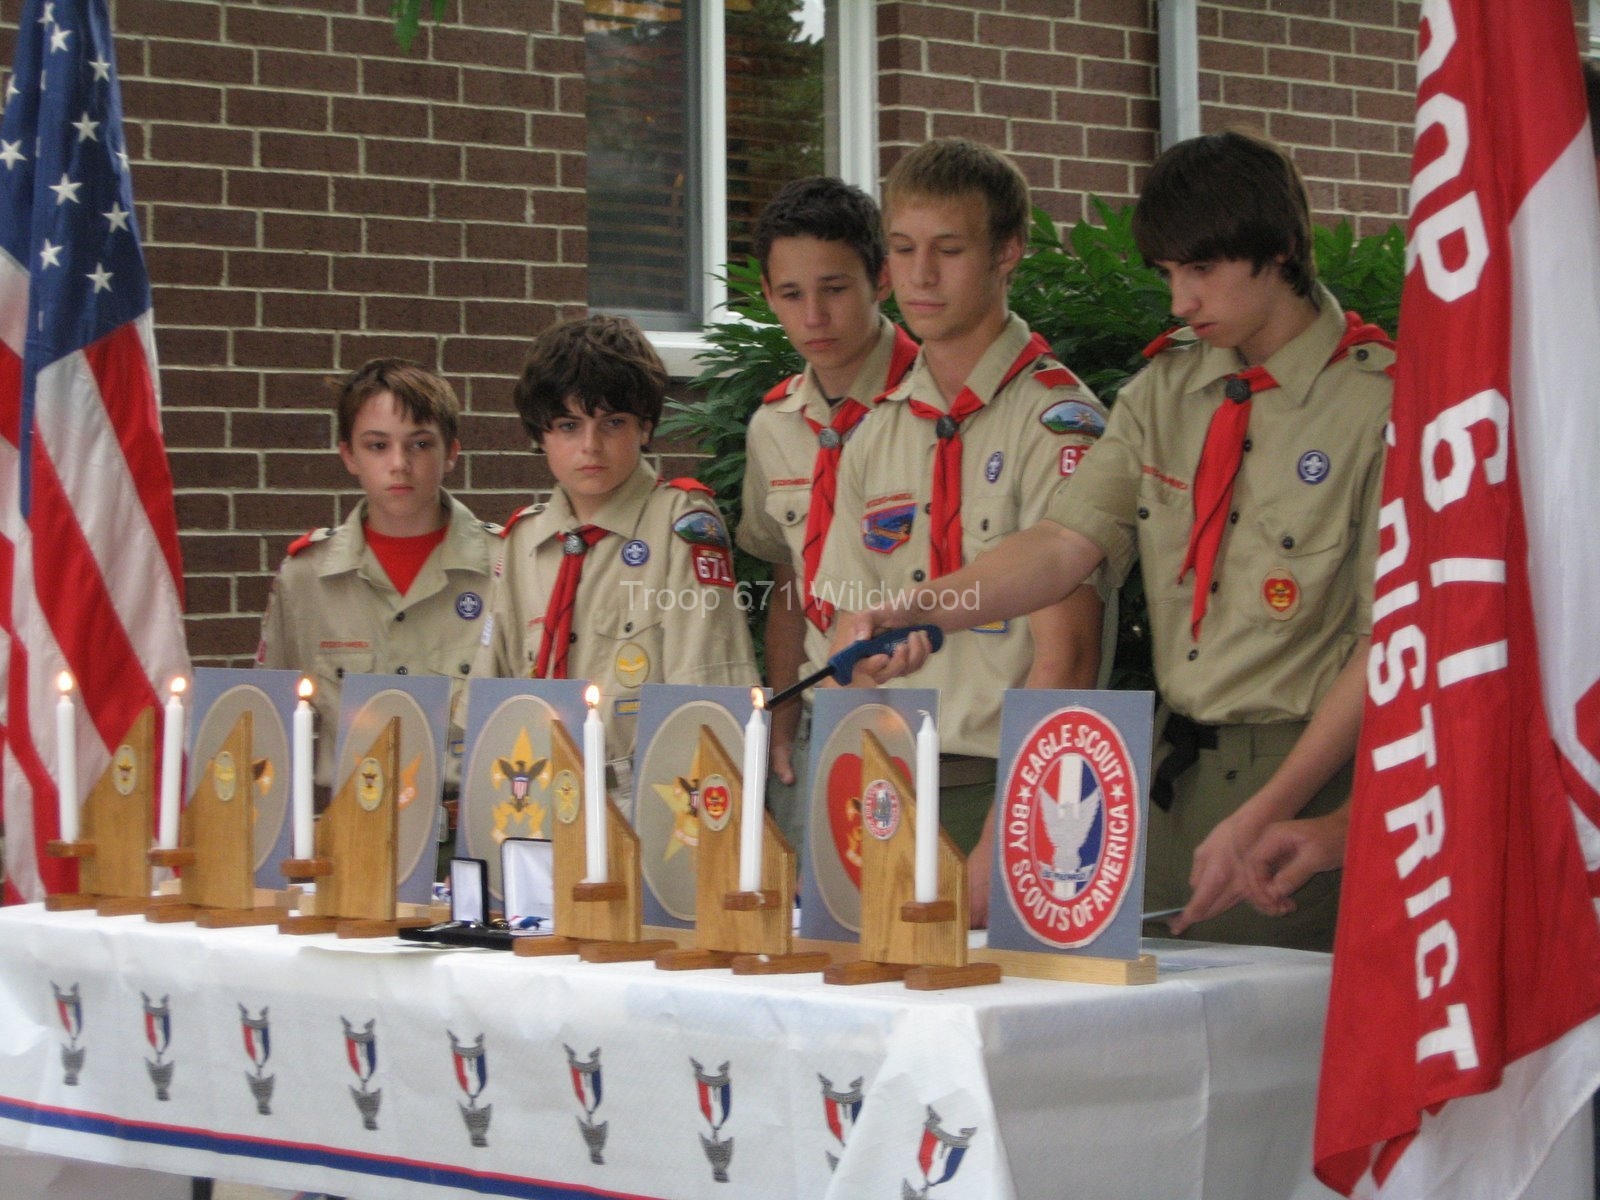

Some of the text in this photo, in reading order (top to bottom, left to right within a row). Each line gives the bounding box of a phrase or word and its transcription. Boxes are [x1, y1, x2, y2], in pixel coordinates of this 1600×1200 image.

[697, 556, 732, 583] 671
[1021, 723, 1123, 786] EAGLE SCOUT
[1008, 803, 1129, 931] BOY SCOUTS OF AMERICA
